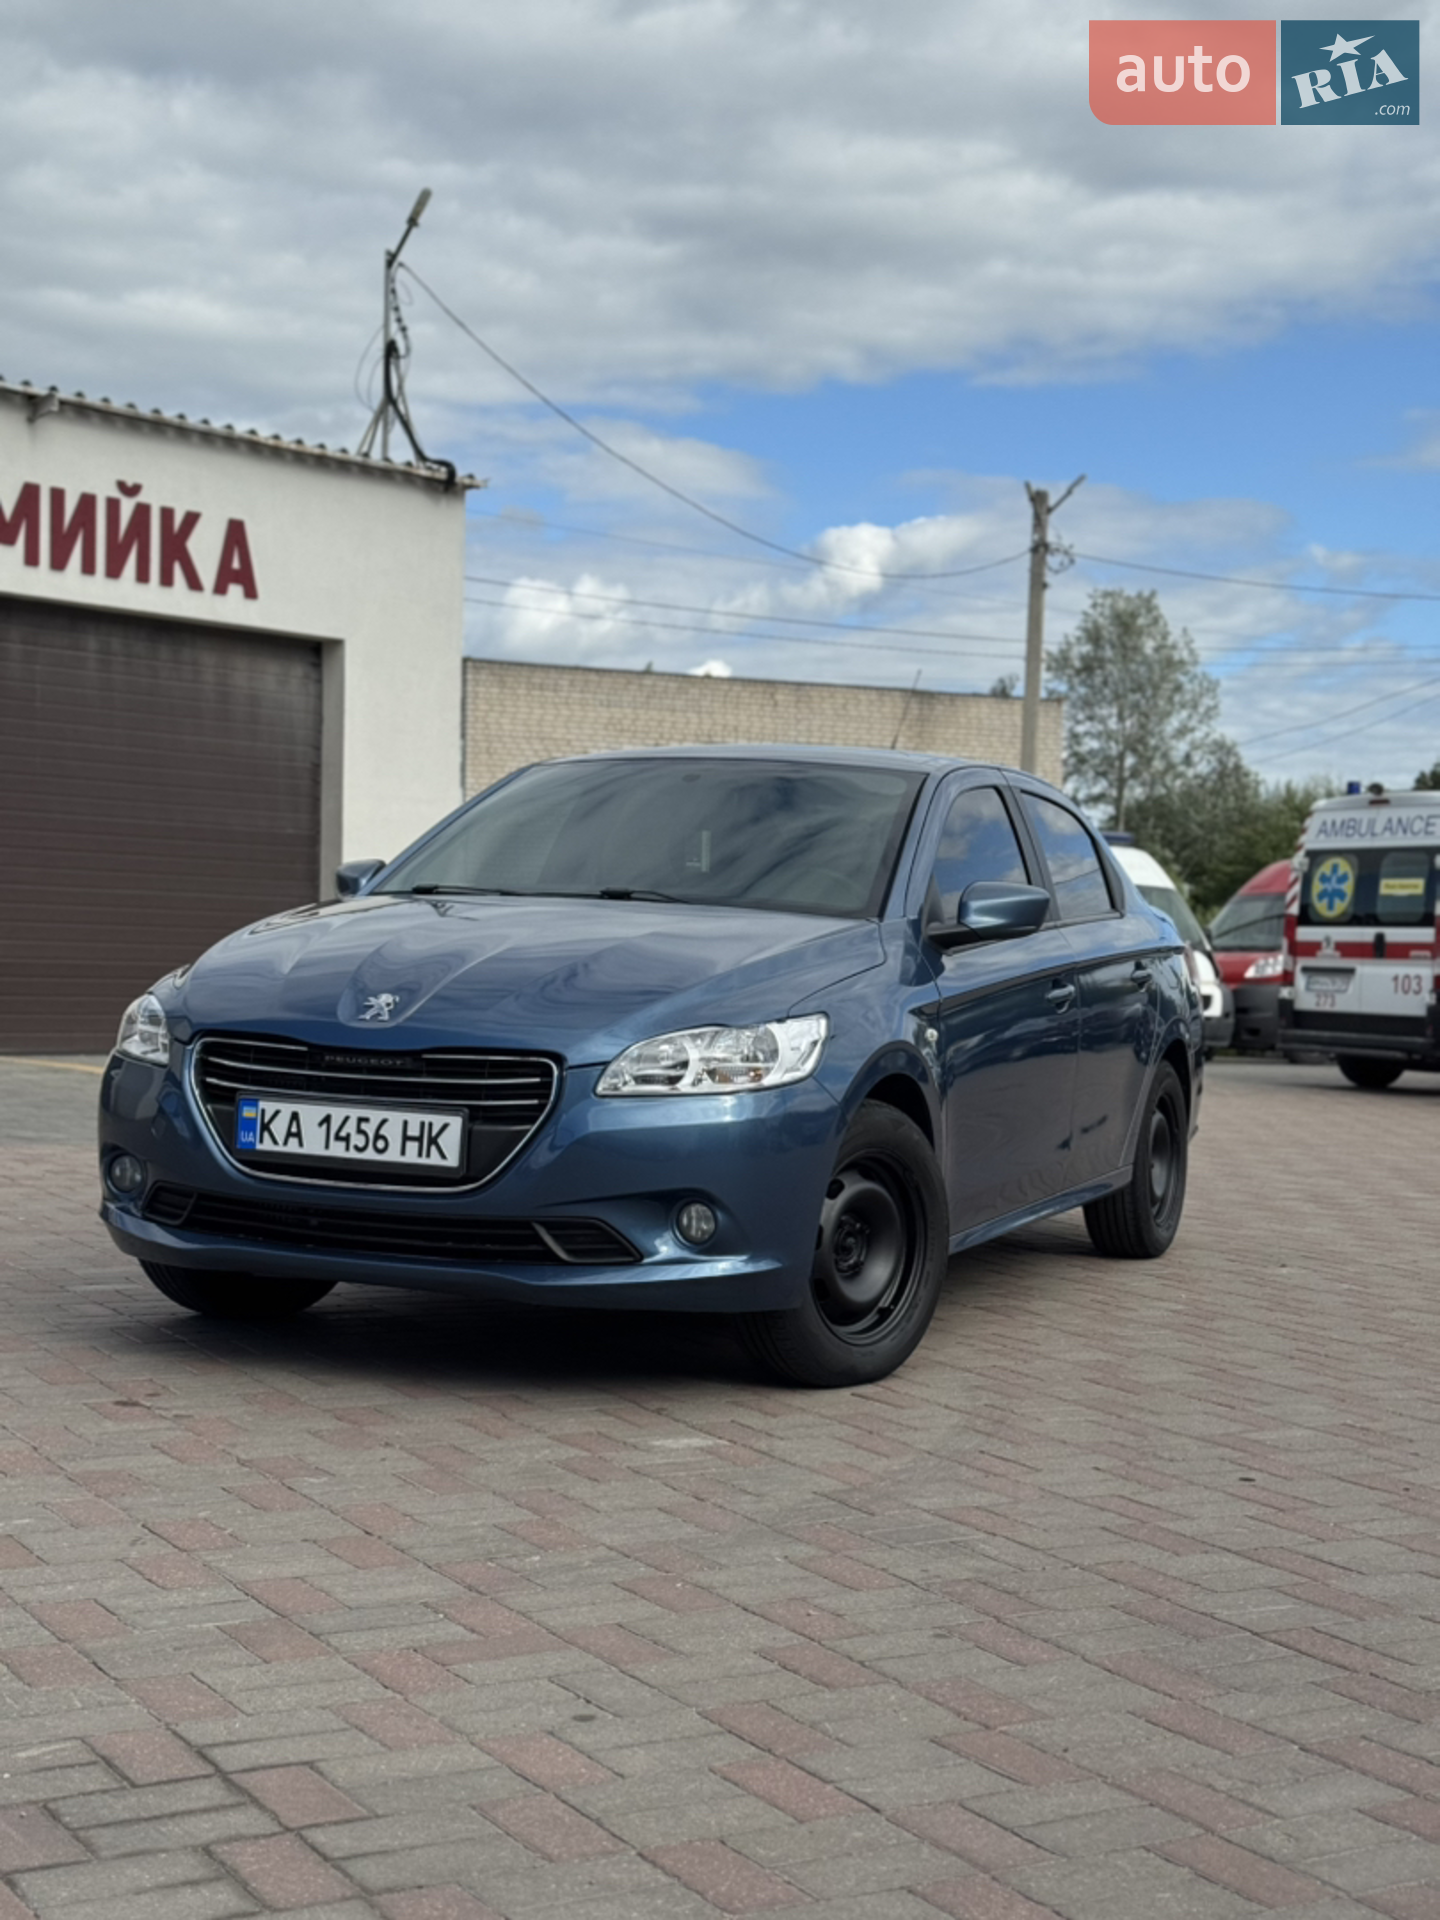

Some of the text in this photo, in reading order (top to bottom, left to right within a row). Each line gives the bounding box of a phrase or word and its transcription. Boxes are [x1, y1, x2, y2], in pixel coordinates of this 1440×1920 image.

[1316, 814, 1440, 839] AMBULANCE
[1391, 973, 1423, 996] 103
[324, 1055, 405, 1067] PEUGEOT
[240, 1131, 255, 1143] UA
[258, 1108, 450, 1160] KA 1456 HK
